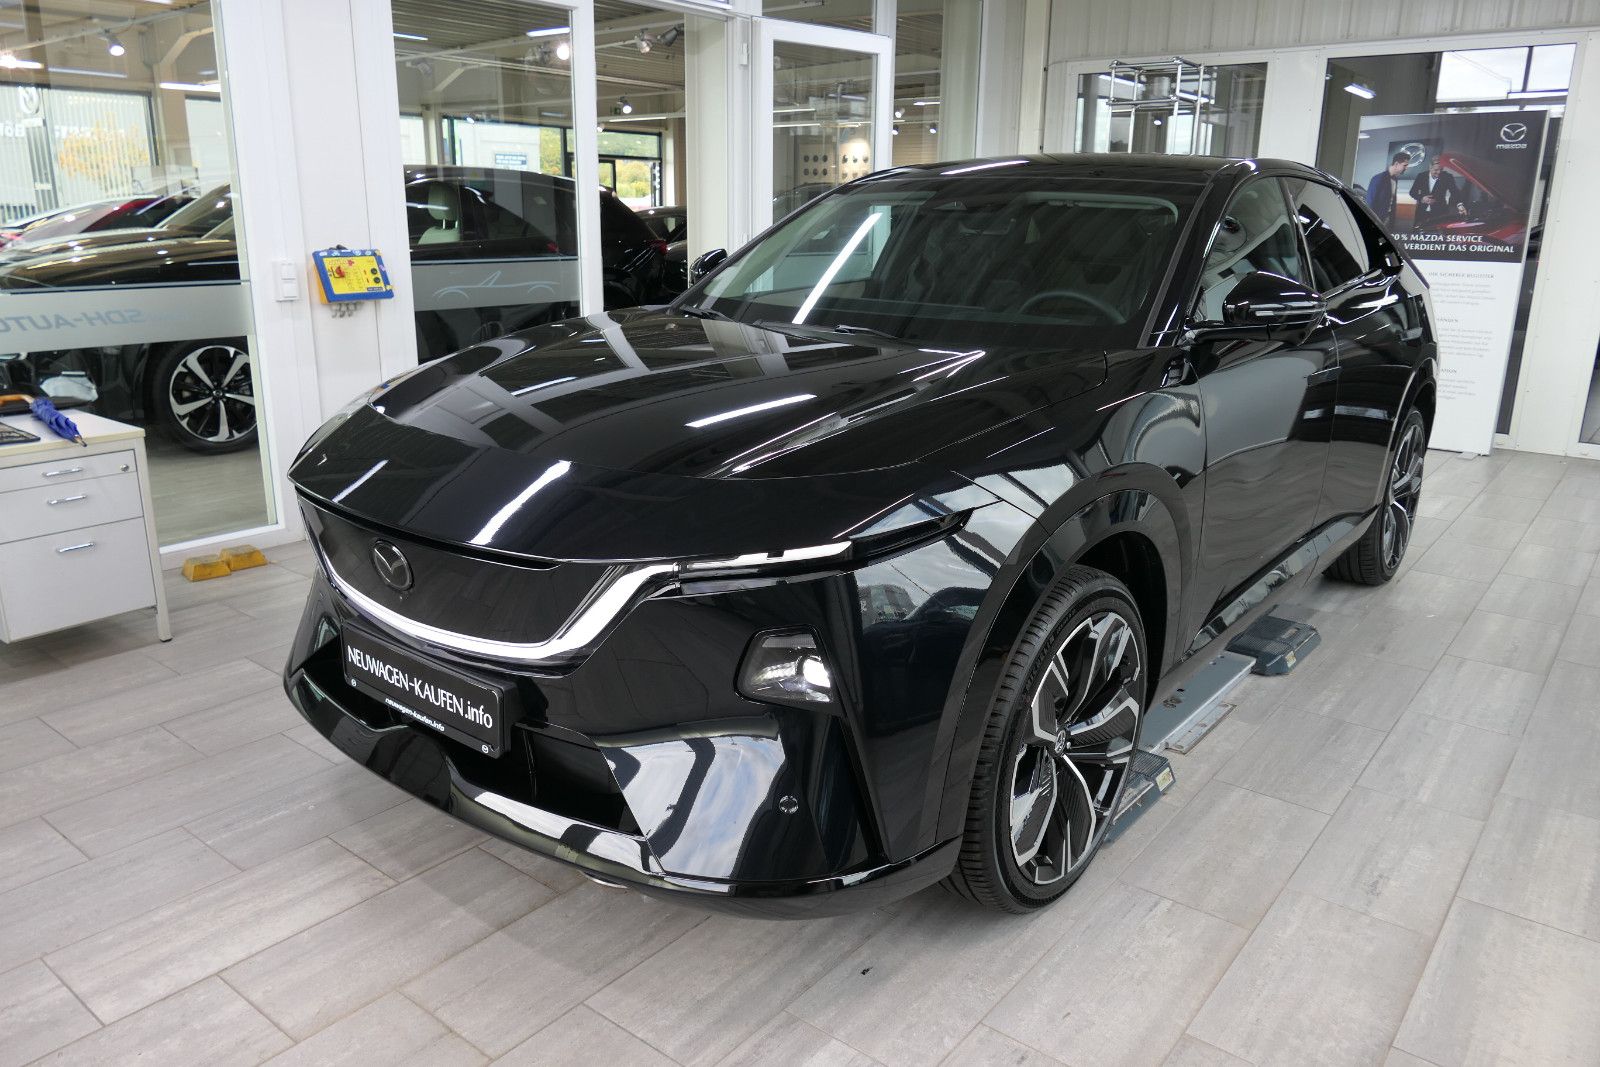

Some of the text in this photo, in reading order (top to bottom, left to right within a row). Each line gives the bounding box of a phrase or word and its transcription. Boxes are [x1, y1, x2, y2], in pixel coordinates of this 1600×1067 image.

[1410, 233, 1444, 242] MAZDA
[1446, 234, 1483, 243] SERVICE
[1404, 243, 1515, 253] VERDIENT DAS ORIGINAL
[347, 645, 493, 729] NEUWAGEN-KAUFEN.info
